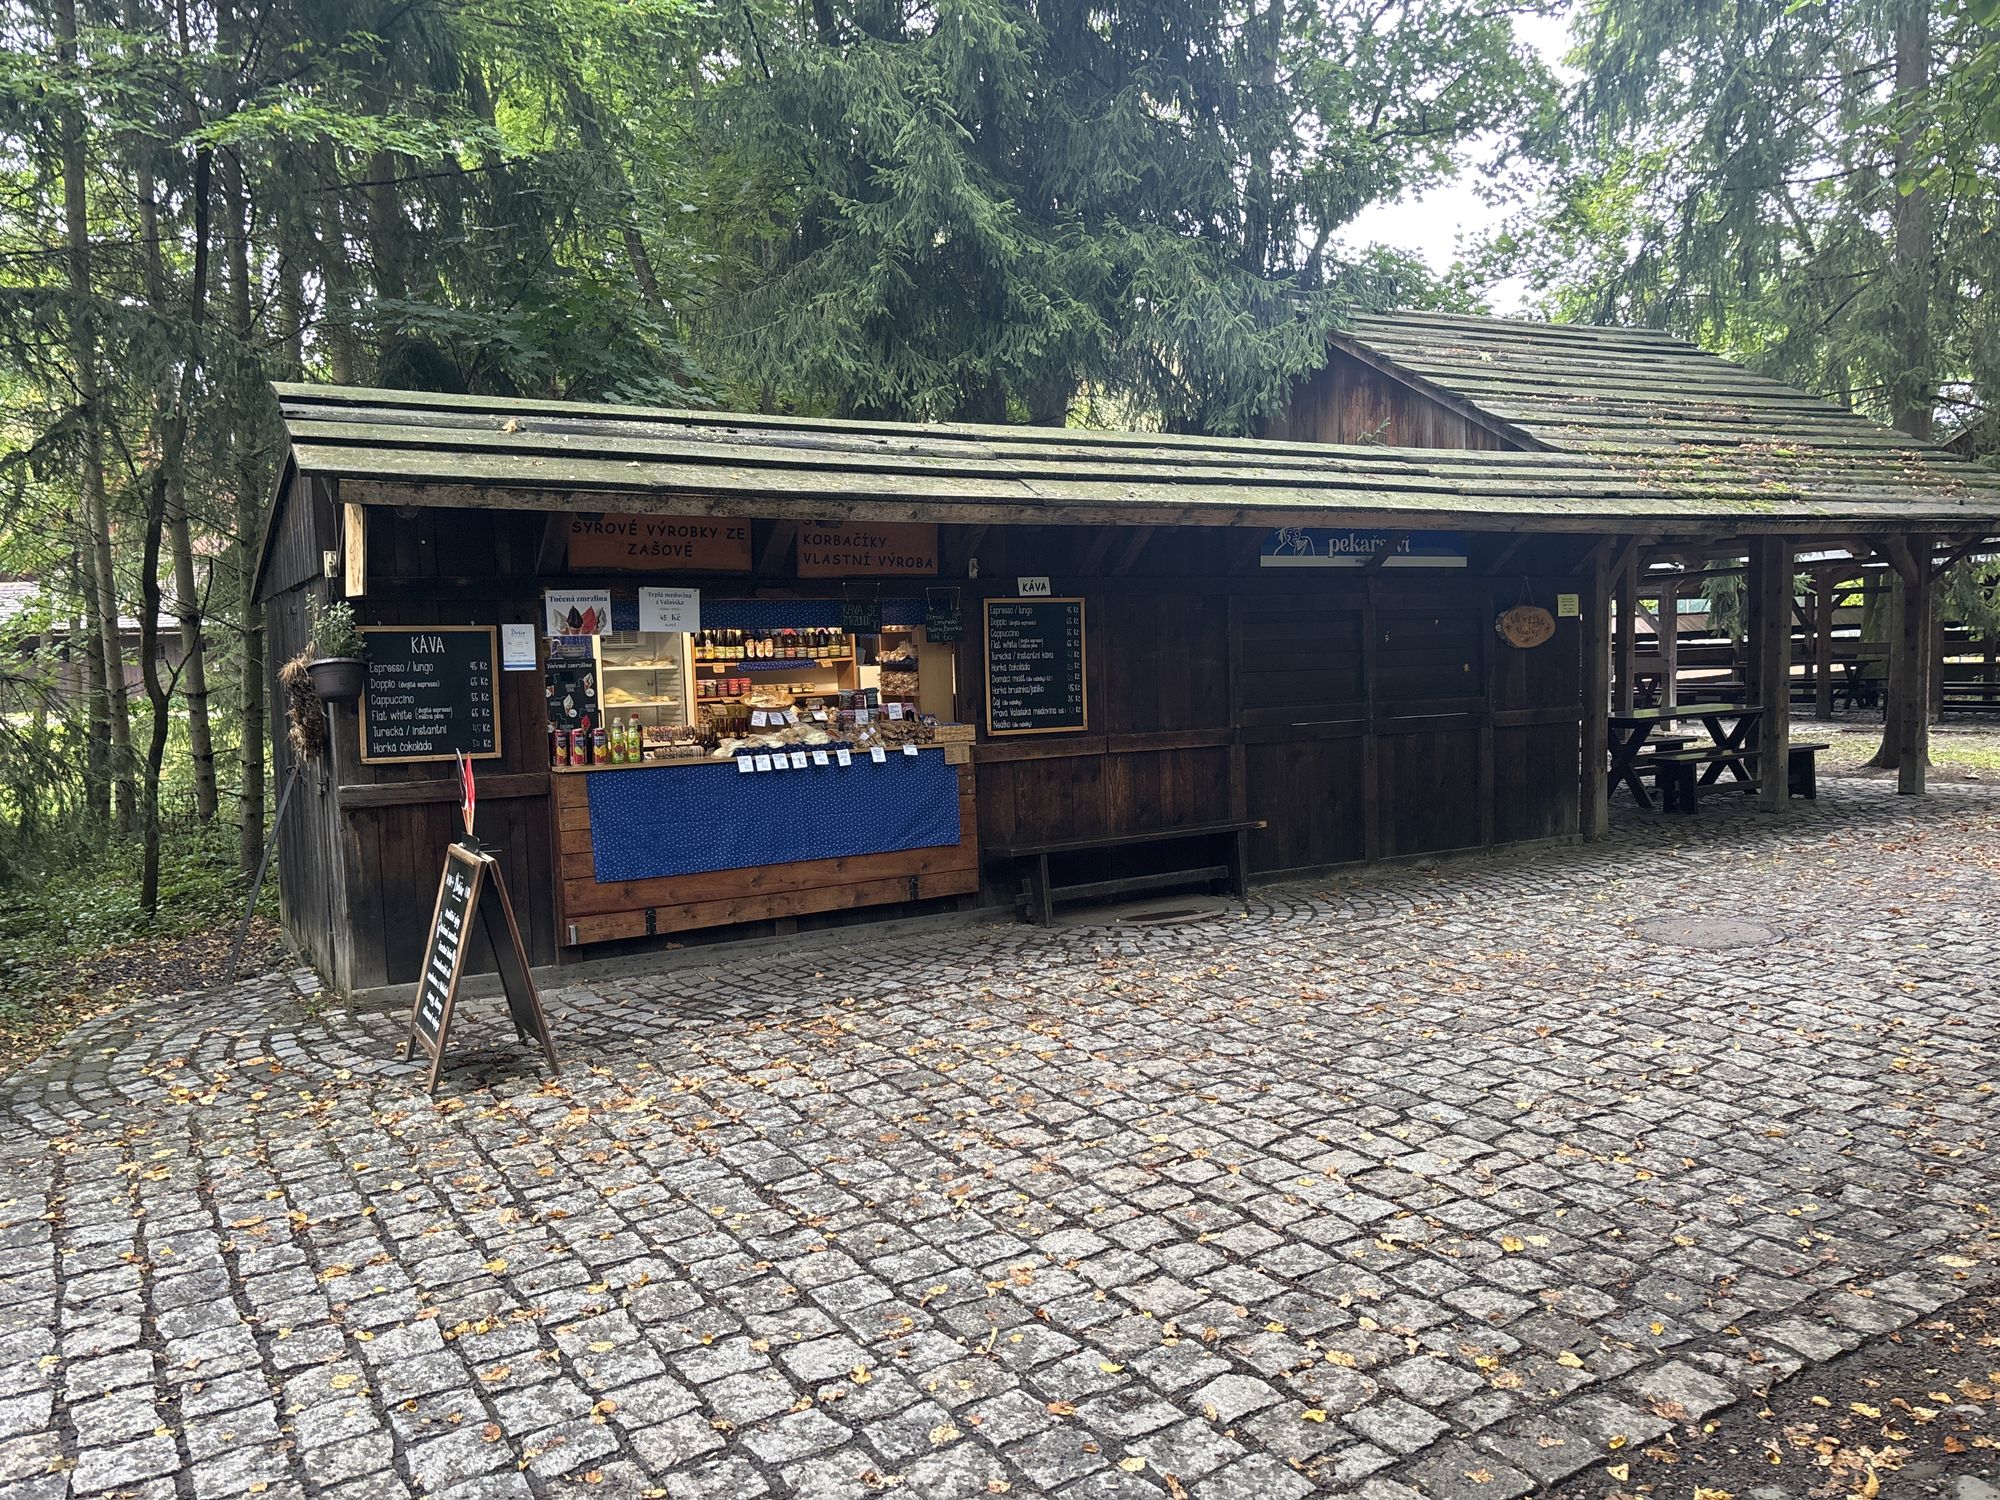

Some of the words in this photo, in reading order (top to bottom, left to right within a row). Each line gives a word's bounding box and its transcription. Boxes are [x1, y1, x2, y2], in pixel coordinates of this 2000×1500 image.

[647, 521, 718, 539] VÝROBKY
[726, 527, 745, 540] ZE
[803, 533, 887, 548] KORBAČÍKY
[627, 541, 693, 557] ZAŠOVÉ
[803, 552, 870, 566] VLASTNÍ
[878, 552, 933, 569] VÝROBA
[1022, 579, 1047, 592] KÁVA
[548, 595, 575, 603] Točená
[576, 594, 608, 602] zmrzlina
[671, 613, 681, 621] Kč
[990, 605, 1013, 616] Espresso
[1018, 605, 1033, 616] lungo
[990, 617, 1007, 628] Doppio
[990, 629, 1019, 639] Cappuccino
[411, 634, 445, 654] KÁVA
[990, 640, 1001, 649] Flat
[1003, 639, 1017, 648] white
[369, 662, 405, 676] Espresso
[412, 661, 434, 675] lungo
[469, 662, 477, 671] 45
[480, 661, 488, 671] Kč
[370, 678, 396, 692] Doppio
[470, 677, 478, 687] 65
[480, 677, 488, 686] Kč
[370, 694, 415, 708] Cappuccino
[471, 692, 478, 702] 55
[481, 692, 490, 701] Kč
[992, 696, 1001, 708] Čaj
[371, 710, 387, 722] Flat
[390, 709, 412, 721] white
[471, 708, 479, 718] 65
[482, 707, 490, 717] Kč
[412, 724, 448, 736] instantní
[482, 723, 491, 733] Kč
[483, 739, 492, 748] Kč
